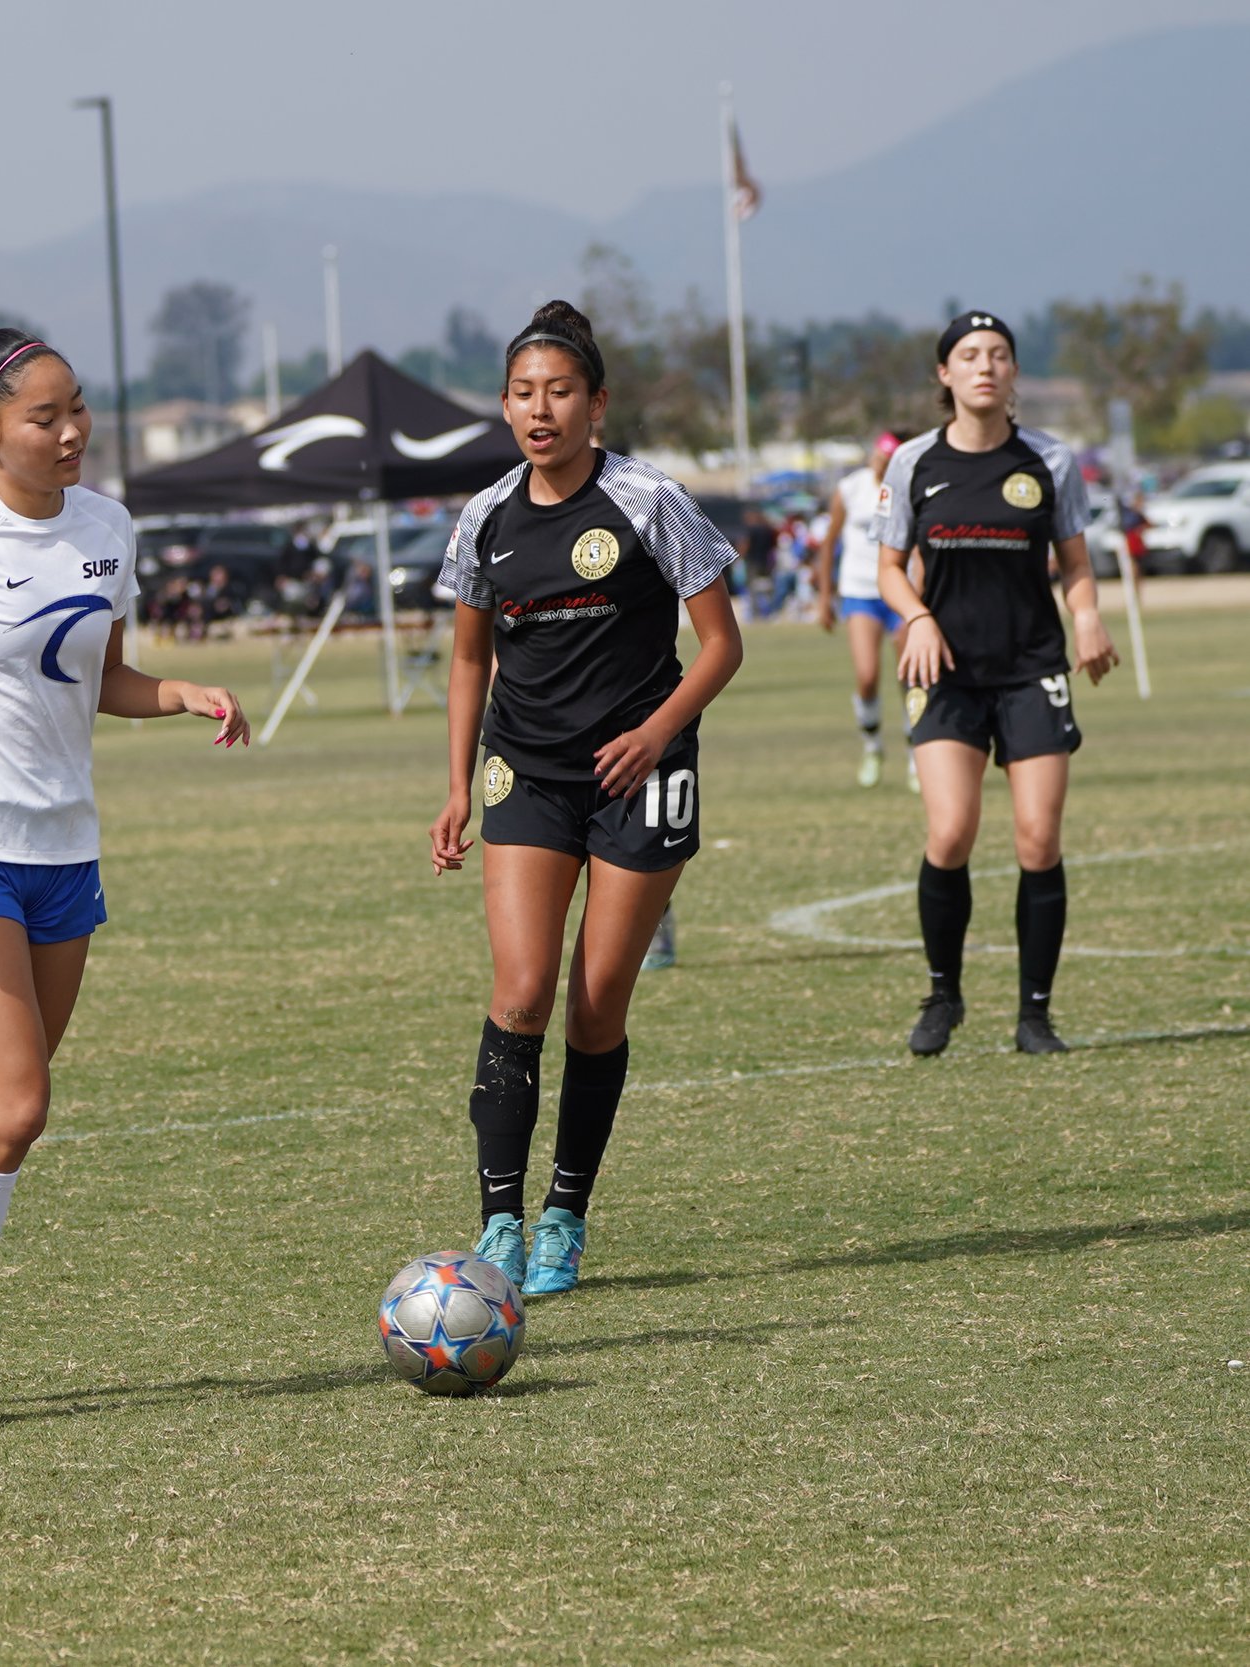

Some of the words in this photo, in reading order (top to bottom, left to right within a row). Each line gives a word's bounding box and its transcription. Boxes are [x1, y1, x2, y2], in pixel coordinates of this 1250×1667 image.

[82, 558, 119, 579] SURF
[574, 559, 602, 578] FOOTBALL
[601, 557, 616, 574] CLUB
[640, 768, 696, 830] 10
